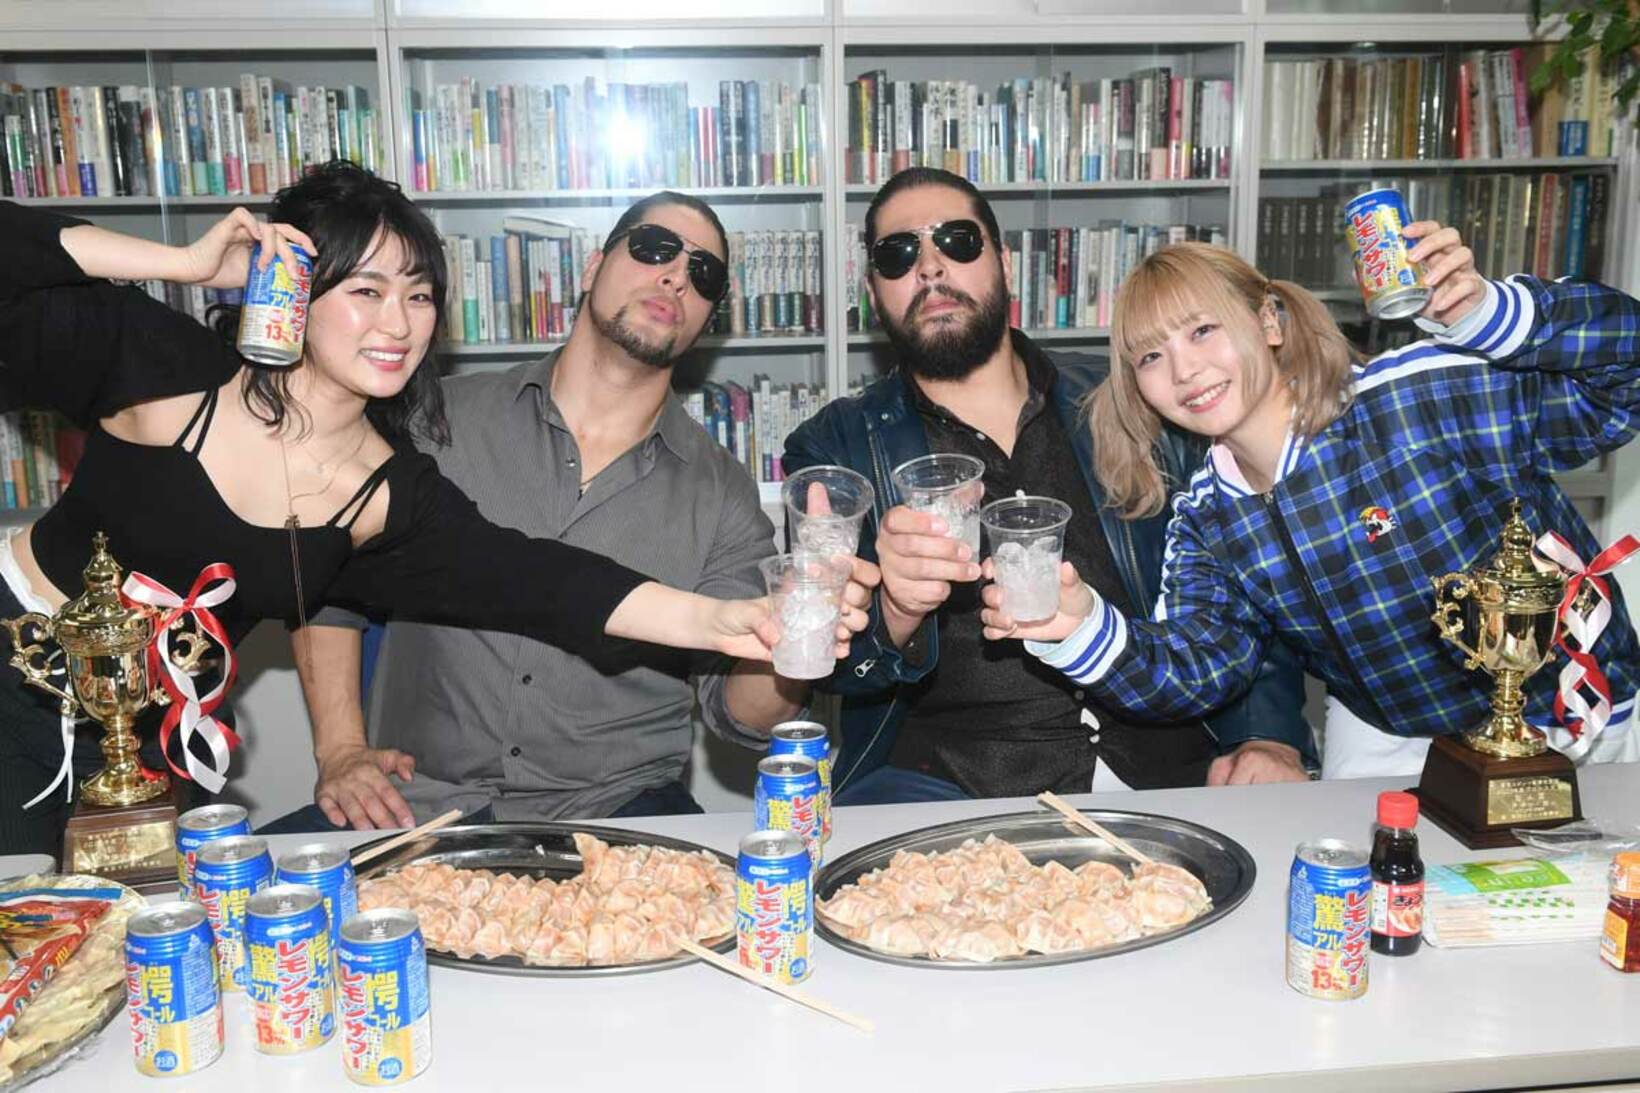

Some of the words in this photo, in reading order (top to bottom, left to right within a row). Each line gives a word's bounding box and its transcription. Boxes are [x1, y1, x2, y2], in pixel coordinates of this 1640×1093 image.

[1342, 891, 1369, 987] レモンサワー
[278, 940, 310, 1040] レモンサワー
